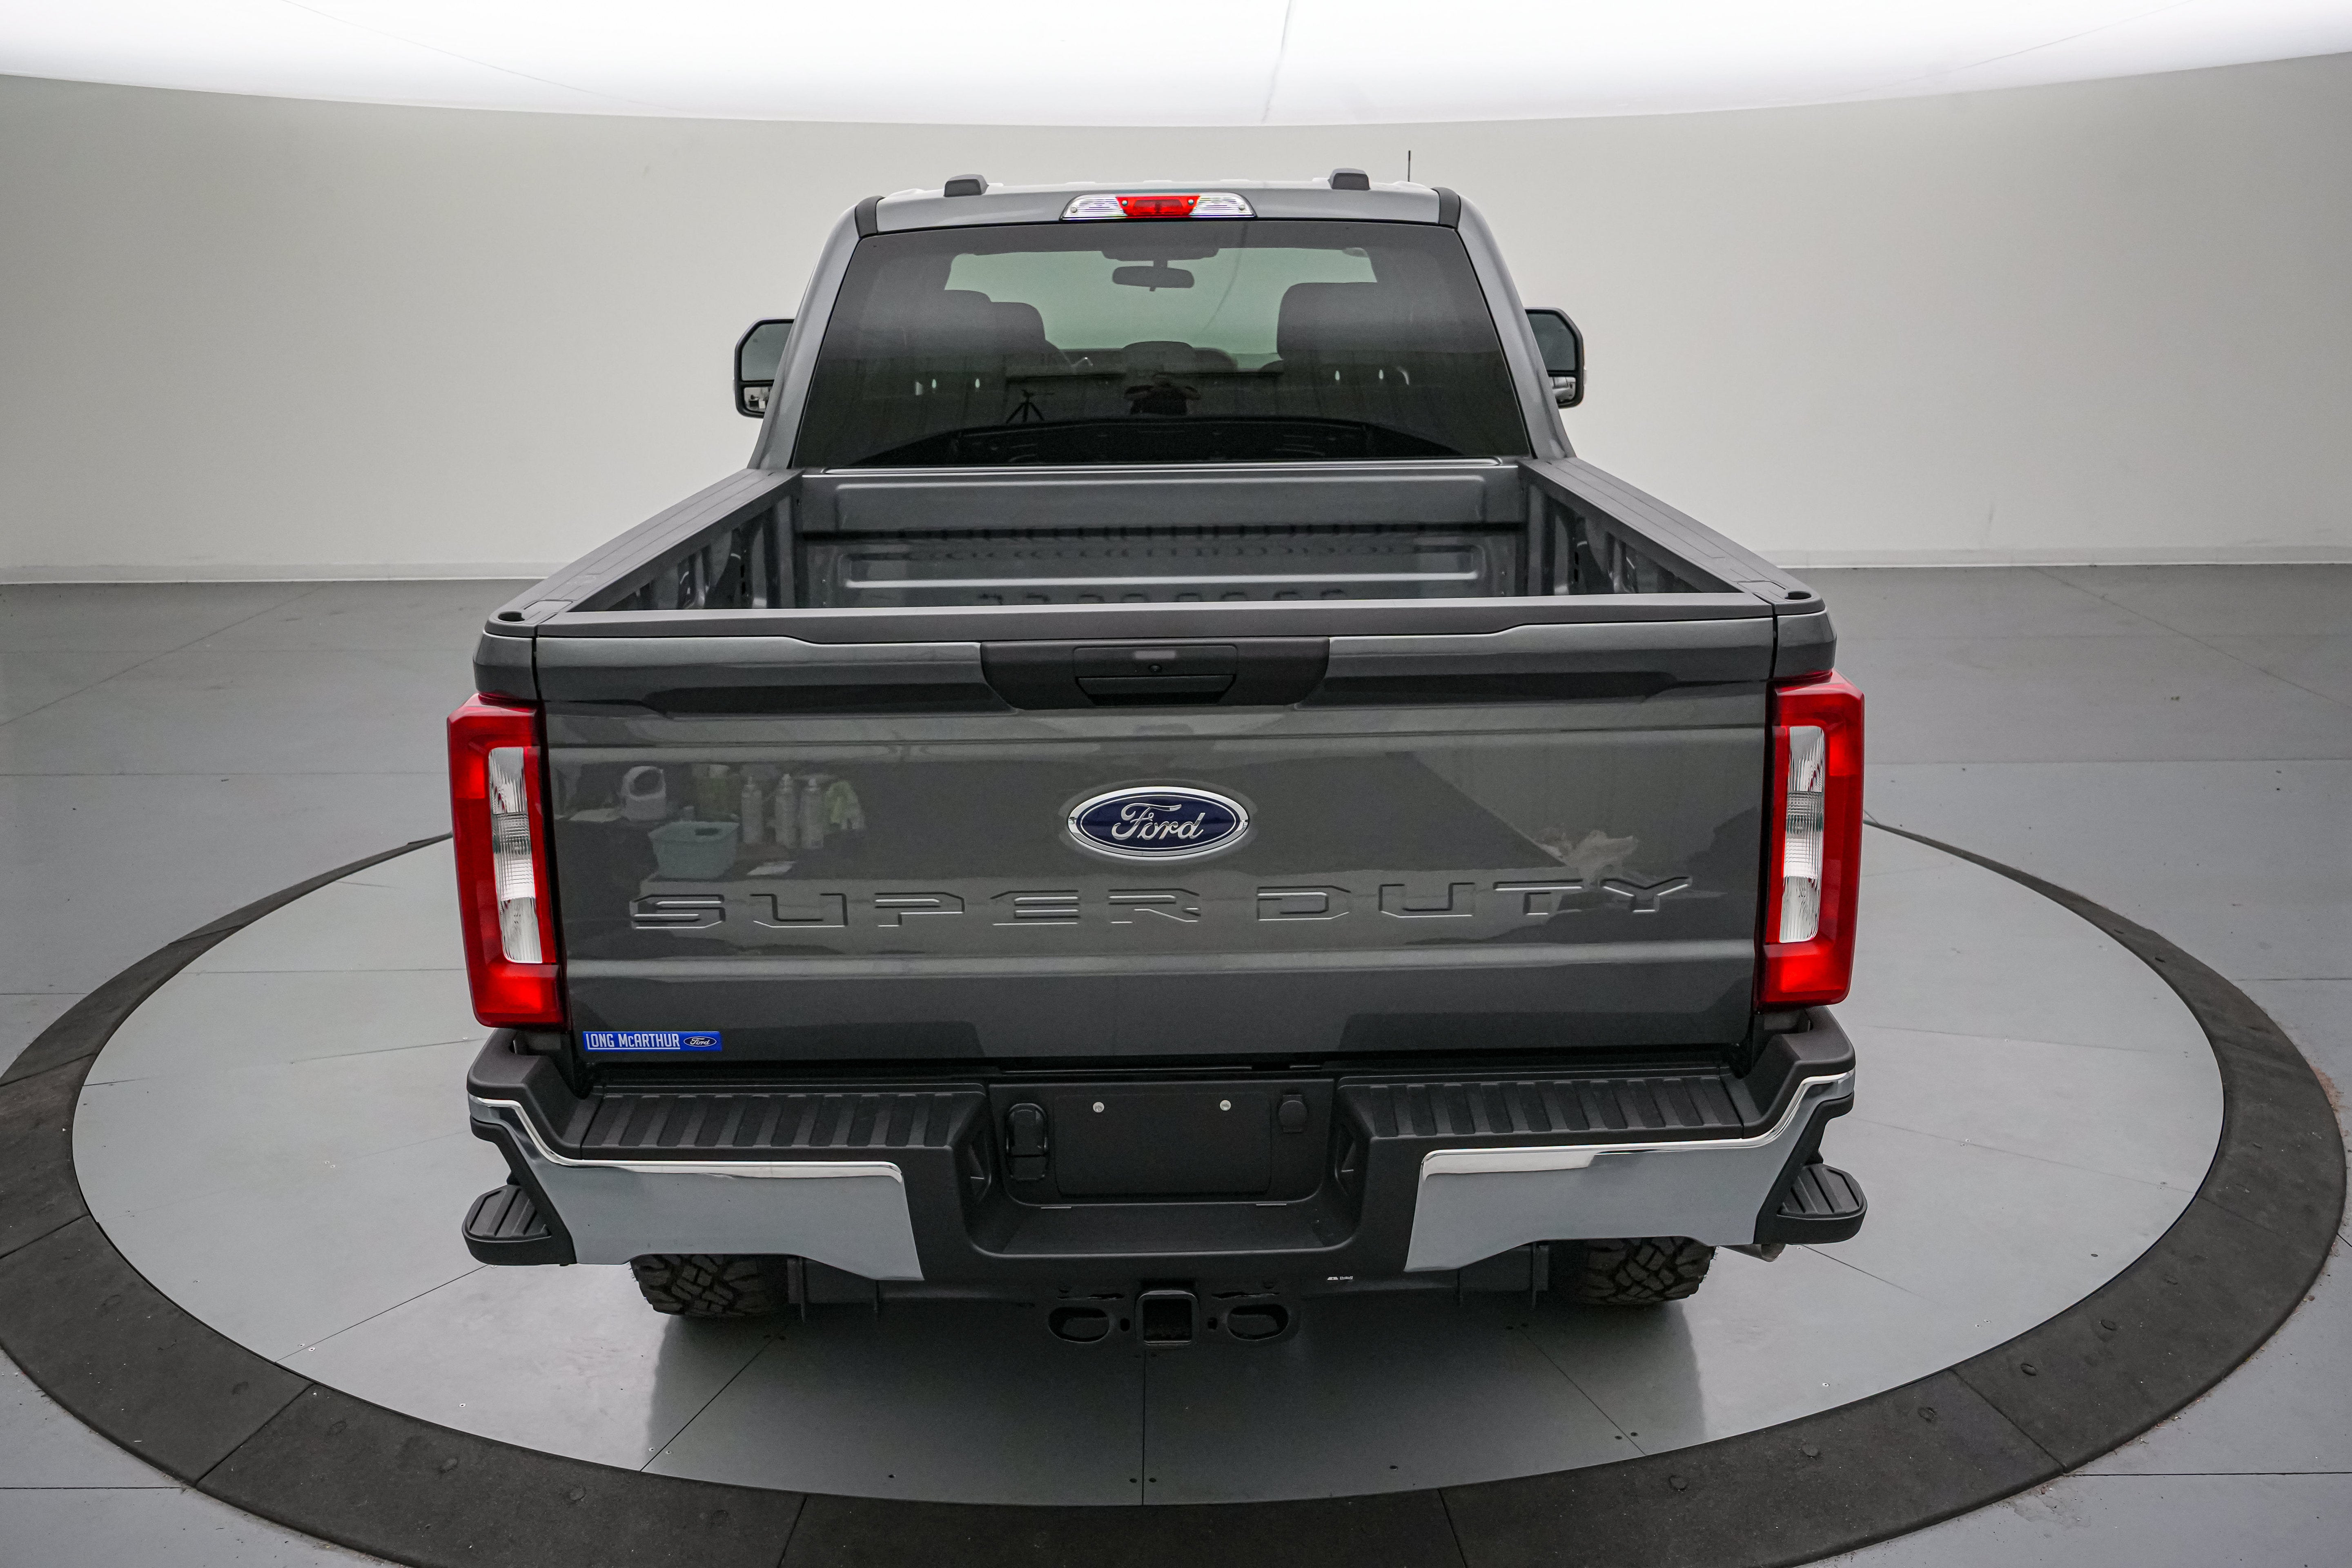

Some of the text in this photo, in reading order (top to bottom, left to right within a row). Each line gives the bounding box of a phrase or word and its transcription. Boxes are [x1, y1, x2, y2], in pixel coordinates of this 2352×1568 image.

[1111, 802, 1206, 841] Ford
[629, 876, 1692, 929] SUPER DUTY
[586, 1033, 681, 1049] LONG McARTHUR
[689, 1037, 710, 1045] Ford
